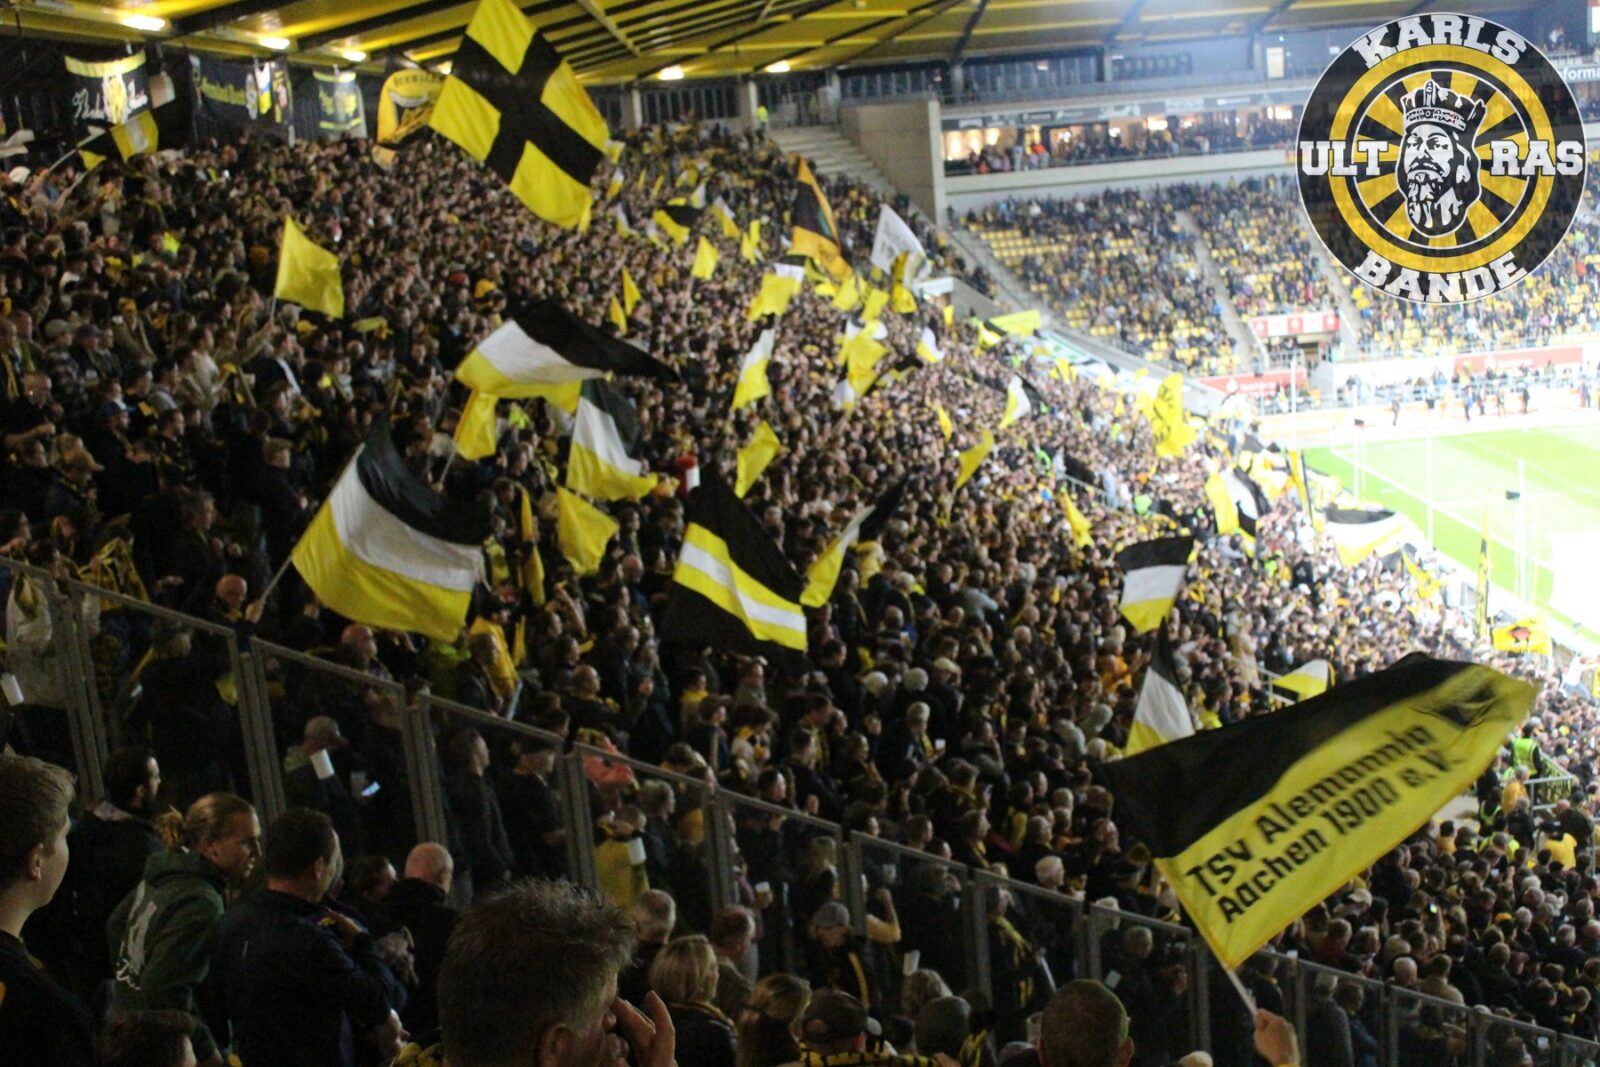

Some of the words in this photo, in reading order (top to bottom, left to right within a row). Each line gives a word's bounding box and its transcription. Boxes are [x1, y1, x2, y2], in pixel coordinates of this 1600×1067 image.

[1186, 837, 1254, 897] TSV
[1255, 724, 1435, 845] Alemannia
[1216, 828, 1328, 924] Aachen
[1320, 776, 1400, 835] 1900
